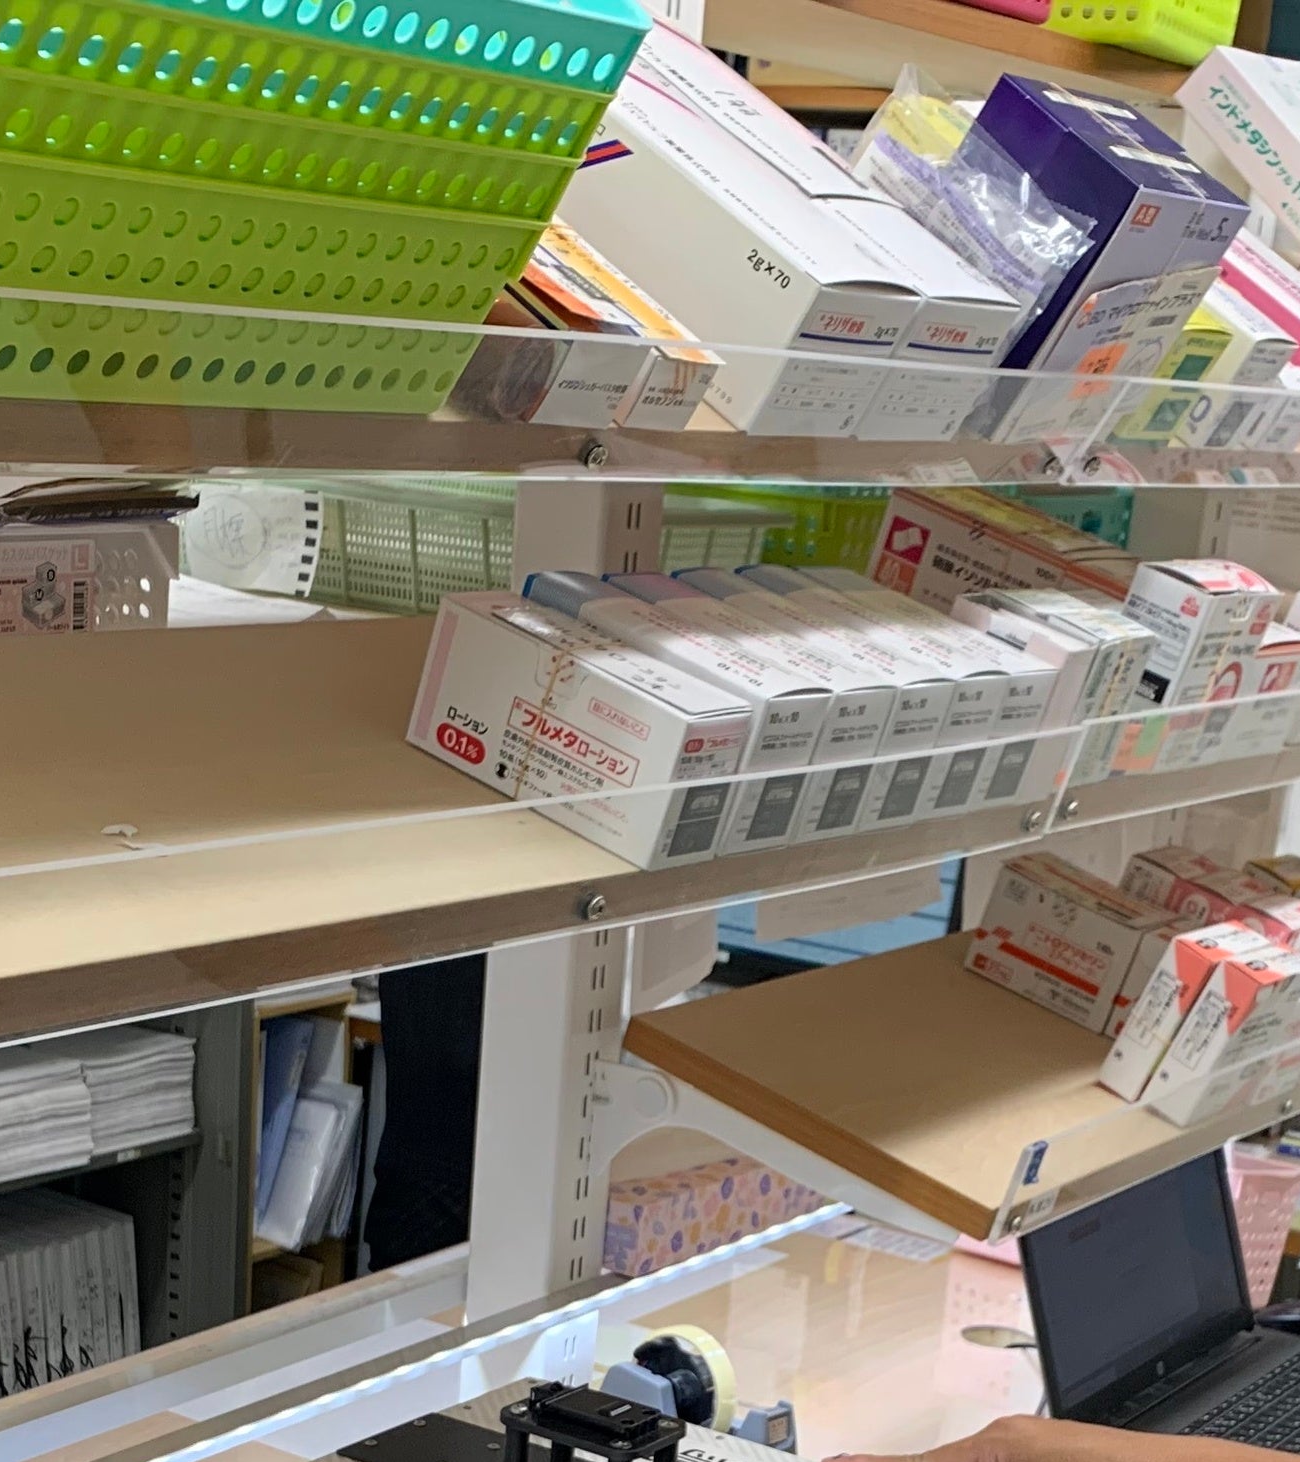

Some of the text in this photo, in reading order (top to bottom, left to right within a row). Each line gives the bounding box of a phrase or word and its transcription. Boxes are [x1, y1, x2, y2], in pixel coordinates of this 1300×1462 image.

[747, 249, 792, 290] 2g×70
[446, 705, 489, 736] ローション
[443, 729, 478, 760] 0.1%
[522, 708, 629, 776] フルメタローション
